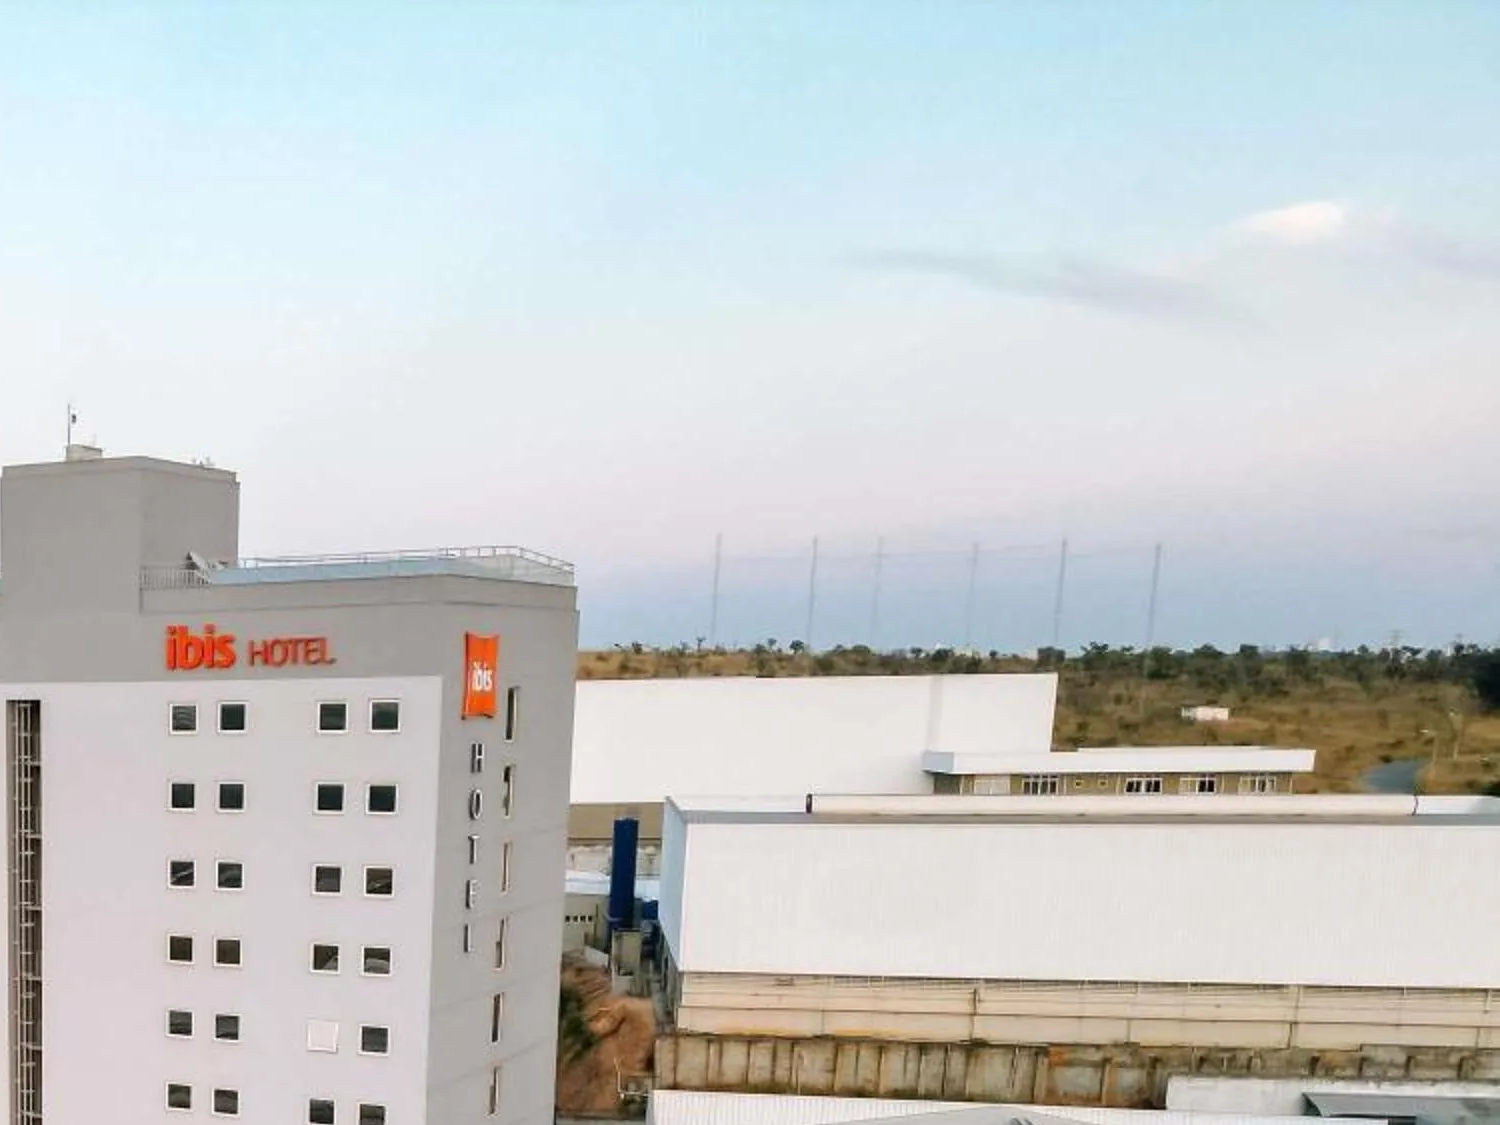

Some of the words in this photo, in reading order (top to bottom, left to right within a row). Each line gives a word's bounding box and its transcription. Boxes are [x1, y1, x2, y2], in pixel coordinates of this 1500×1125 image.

[166, 623, 237, 671] ibis
[247, 636, 338, 667] HOTEL
[472, 660, 493, 692] ibis
